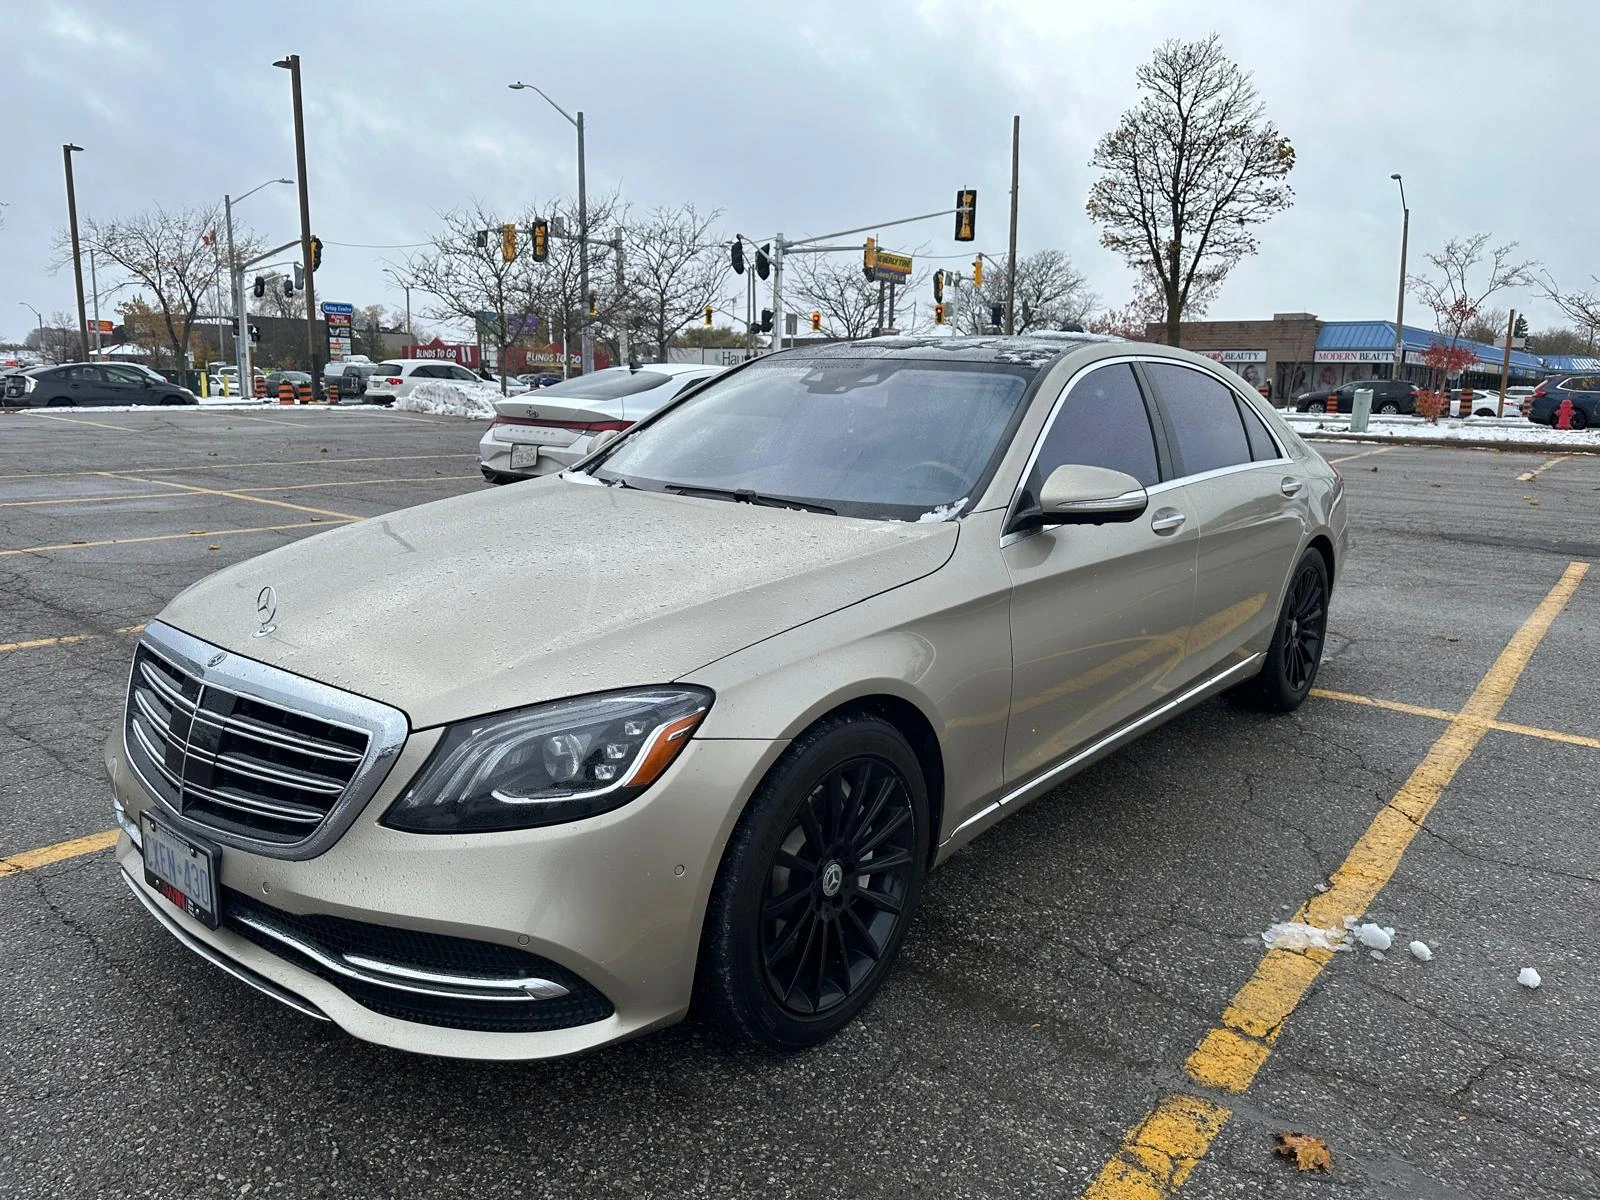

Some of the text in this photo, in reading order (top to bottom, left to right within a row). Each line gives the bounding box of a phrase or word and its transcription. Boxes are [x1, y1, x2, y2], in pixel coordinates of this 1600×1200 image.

[416, 348, 435, 358] BLINDS
[526, 351, 554, 362] BLINDS
[1225, 352, 1259, 360] BEAUTY
[1318, 352, 1395, 361] MODERN BEAUTY
